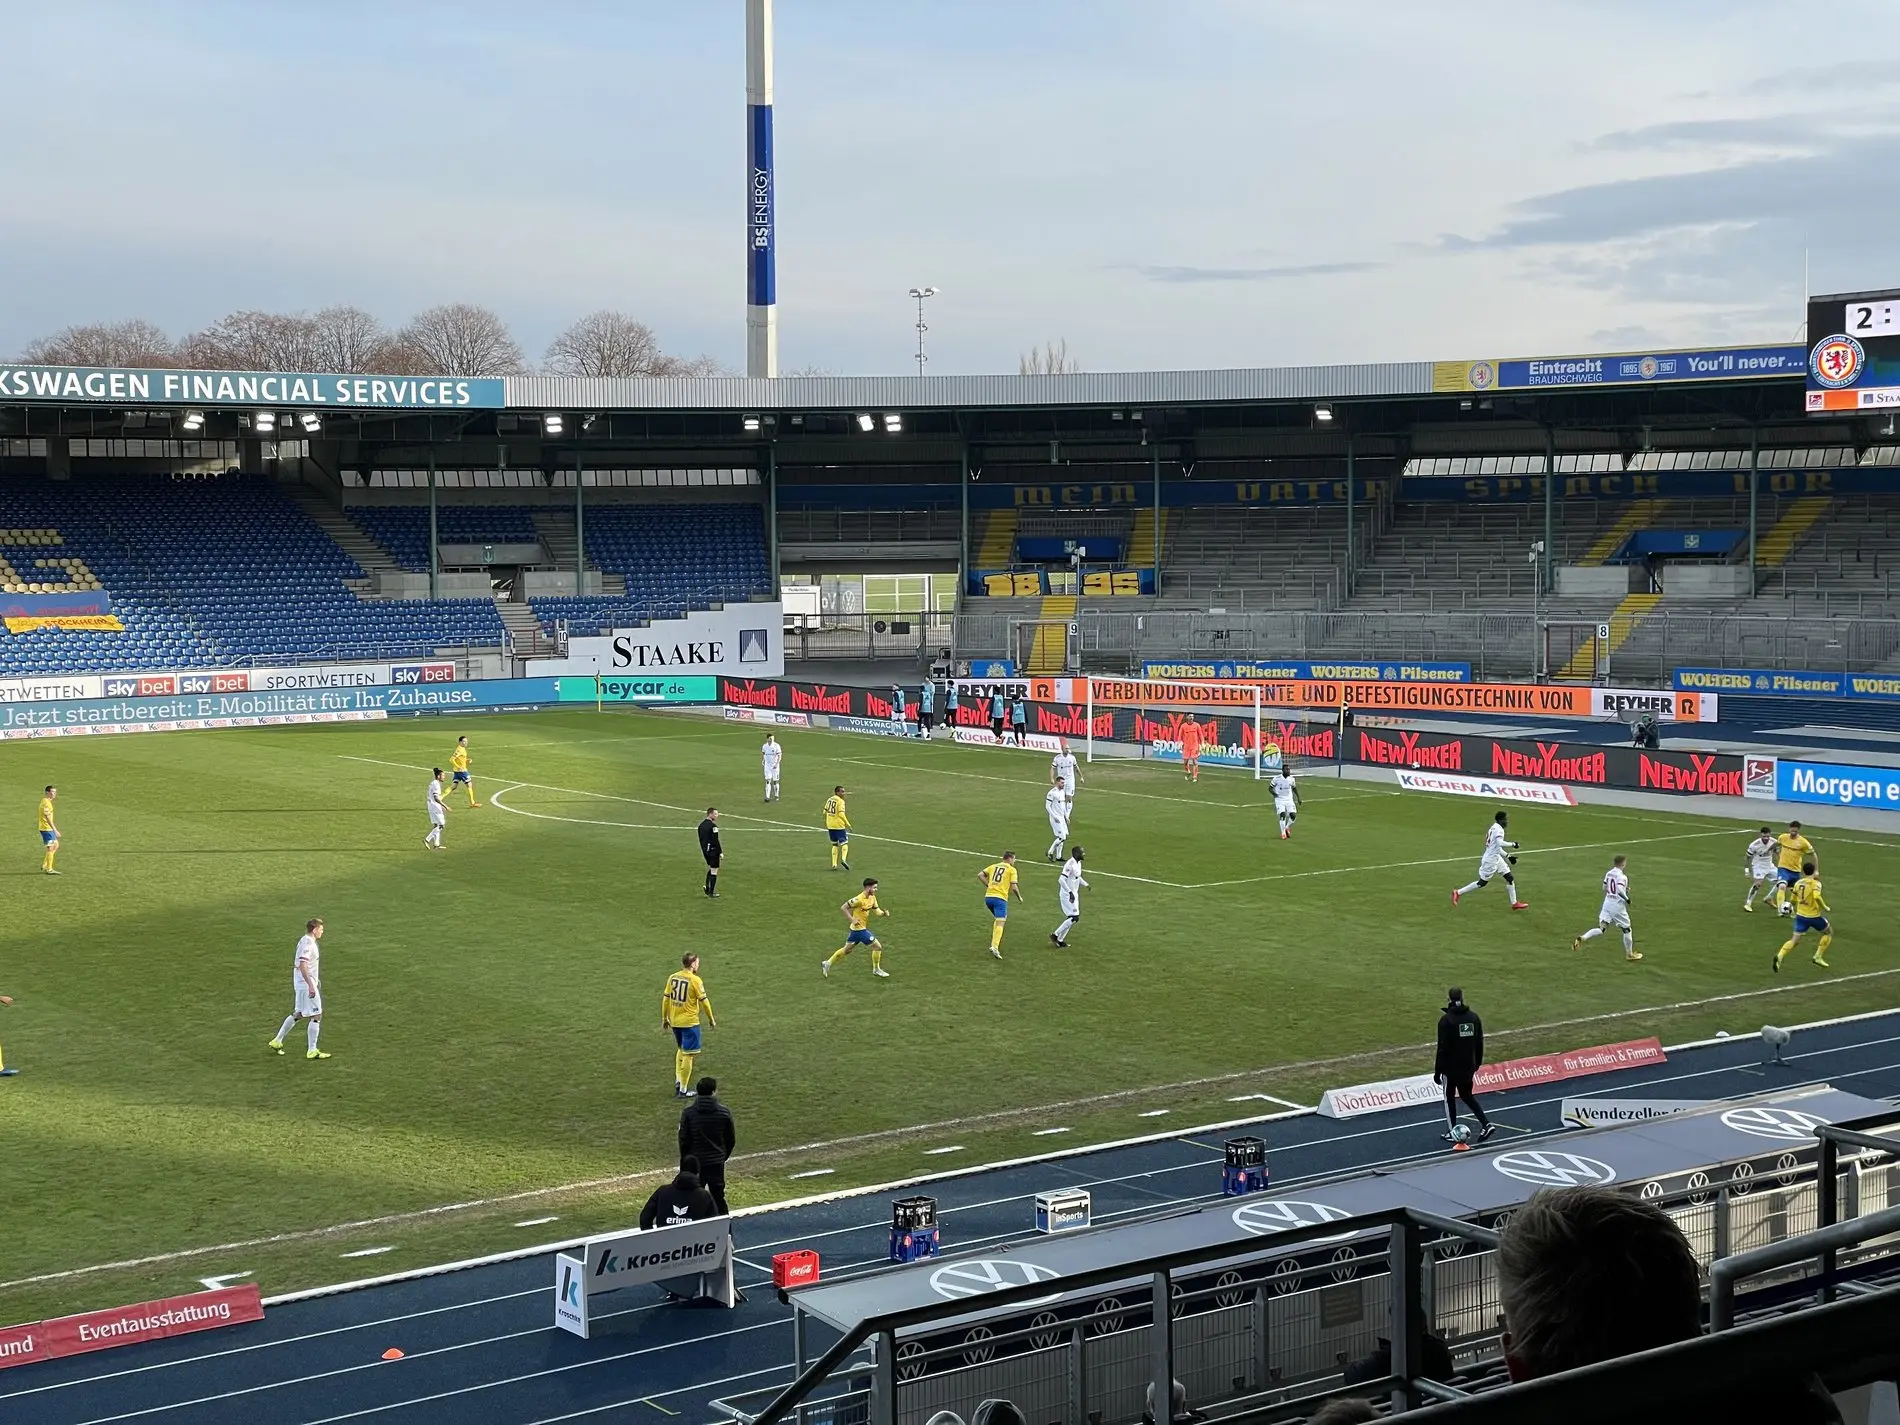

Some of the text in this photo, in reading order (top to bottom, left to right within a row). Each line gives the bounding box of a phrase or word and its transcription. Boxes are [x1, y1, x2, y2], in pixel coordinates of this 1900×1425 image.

[1857, 307, 1872, 329] 2
[1529, 359, 1603, 375] Eintracht
[1622, 364, 1638, 374] 1895
[1660, 362, 1674, 372] 1967
[1688, 355, 1733, 372] You'll
[1529, 373, 1603, 386] BRAUNSCHWEIG
[164, 374, 326, 402] FINANCIAL
[336, 379, 471, 405] SERVICES
[1070, 624, 1078, 634] 9
[1600, 626, 1607, 637] 8
[559, 632, 568, 643] 10
[612, 636, 725, 668] STAAKE
[395, 668, 451, 684] sky bet
[1147, 664, 1298, 678] WOLTERS Pilsener
[1311, 665, 1463, 681] WOLTERS Pilsener
[107, 679, 171, 697] sky bet
[183, 676, 245, 693] sky bet
[267, 673, 375, 689] SPORTWETTEN
[1680, 672, 1839, 692] WOLTERS Pilsener
[1092, 682, 1573, 710] VERBINDUNGSELEMENTE UND BEFESTIGUNGSTECHNIK VON
[1603, 694, 1672, 713] REYHER
[4, 688, 476, 726] Jetzt startbereit: E-Mobilität für Ihr Zuhause.
[725, 710, 753, 719] sky bet
[776, 714, 806, 725] sky bet
[850, 719, 902, 730] VOLKSWAGN
[1401, 775, 1559, 800] KÜCHEN AKTUELL
[1792, 768, 1881, 803] Morgen
[993, 866, 1005, 882] 18
[671, 979, 688, 1003] 30
[1334, 1089, 1405, 1112] Northern
[1474, 1074, 1505, 1086] liefern
[1507, 1064, 1554, 1081] Erlebnisse
[1563, 1058, 1578, 1071] für
[1580, 1054, 1617, 1068] Familien
[1618, 1052, 1626, 1061] &
[1055, 1211, 1084, 1224] inSports
[79, 1301, 231, 1342] Eventausstattung
